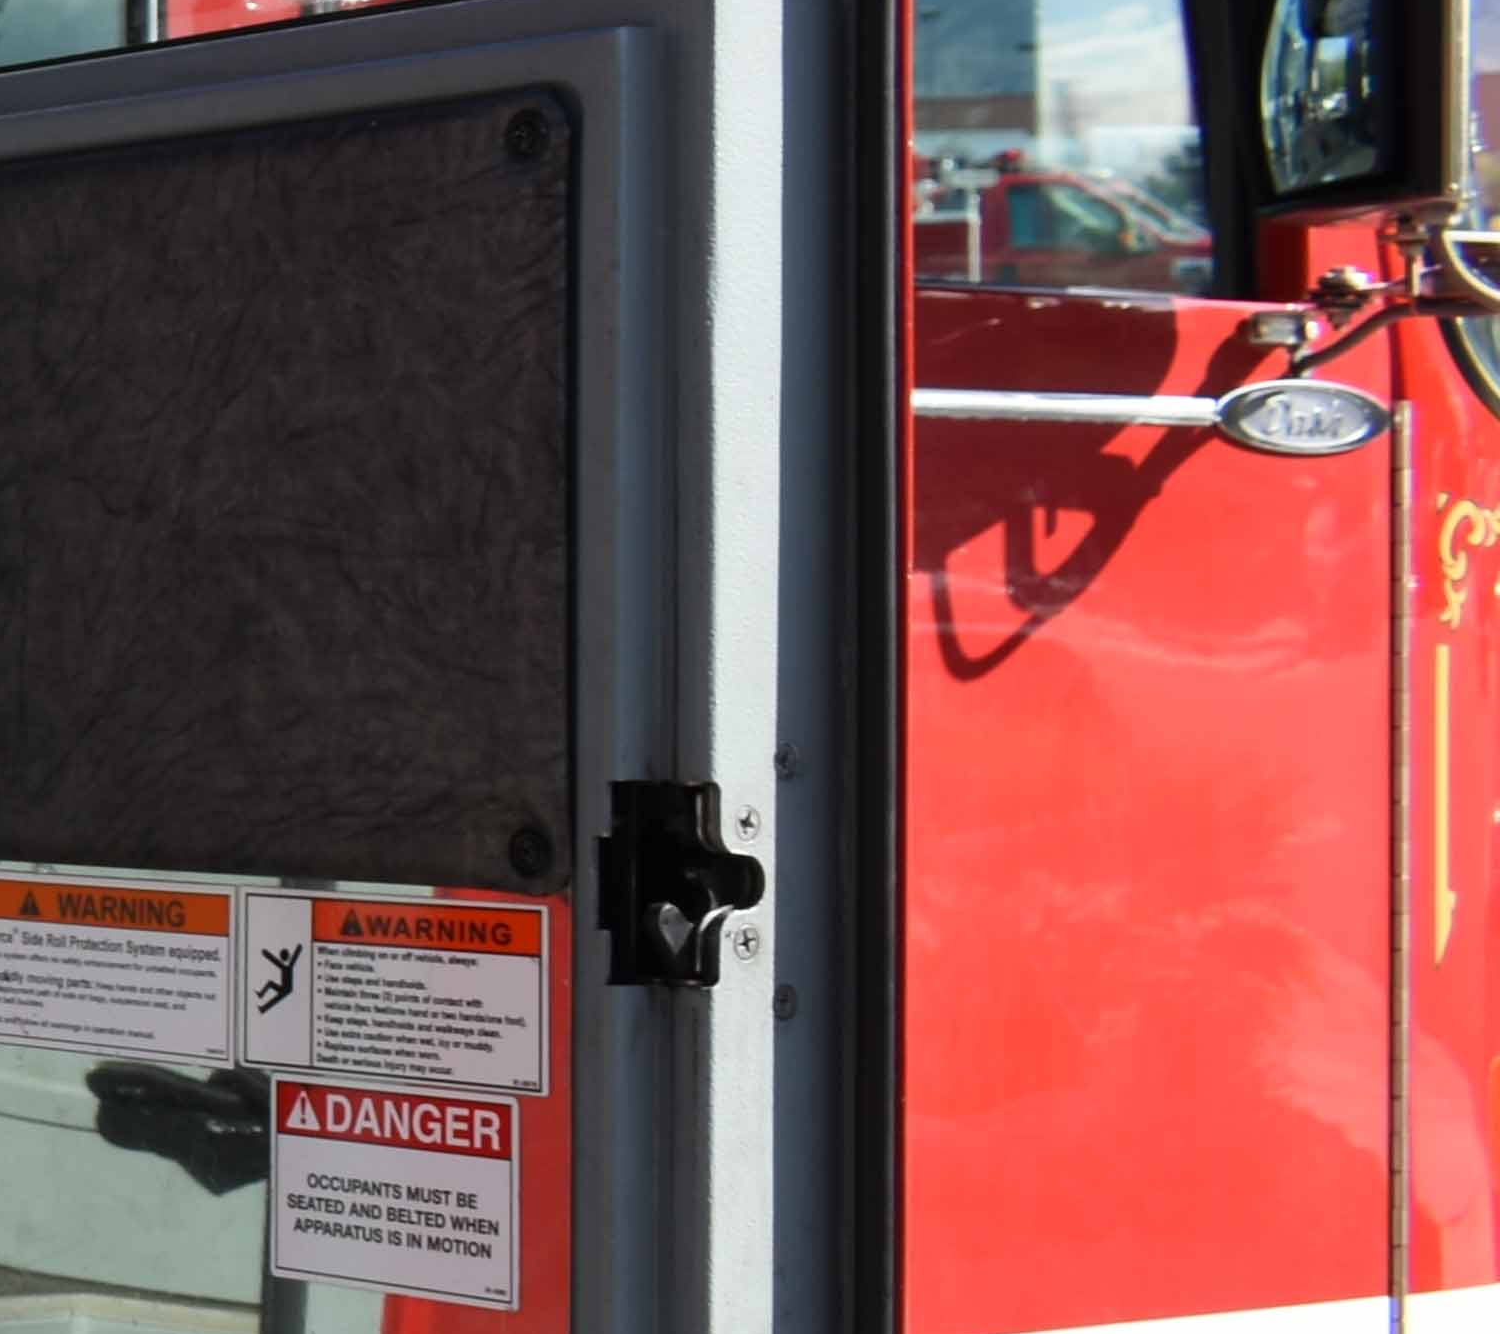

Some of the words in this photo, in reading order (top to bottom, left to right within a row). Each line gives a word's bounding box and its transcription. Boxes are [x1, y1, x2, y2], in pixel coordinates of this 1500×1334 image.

[58, 893, 186, 926] WARNING
[21, 931, 42, 945] Side
[46, 933, 65, 947] Roll
[70, 935, 122, 952] Protection
[127, 940, 164, 959] System
[169, 944, 220, 964] equipped.
[366, 914, 512, 946] WARNING
[326, 1092, 500, 1152] DANGER
[308, 1172, 401, 1200] OCCUPANTS
[406, 1185, 451, 1206] MUST
[456, 1191, 477, 1210] BE
[287, 1193, 344, 1215] SEATED
[349, 1201, 381, 1220] AND
[386, 1206, 445, 1229] BELTED
[450, 1215, 498, 1236] WHEN
[293, 1216, 382, 1243] APPARATUS
[387, 1229, 401, 1246] IS
[406, 1232, 421, 1249] IN
[427, 1235, 491, 1259] MOTION
